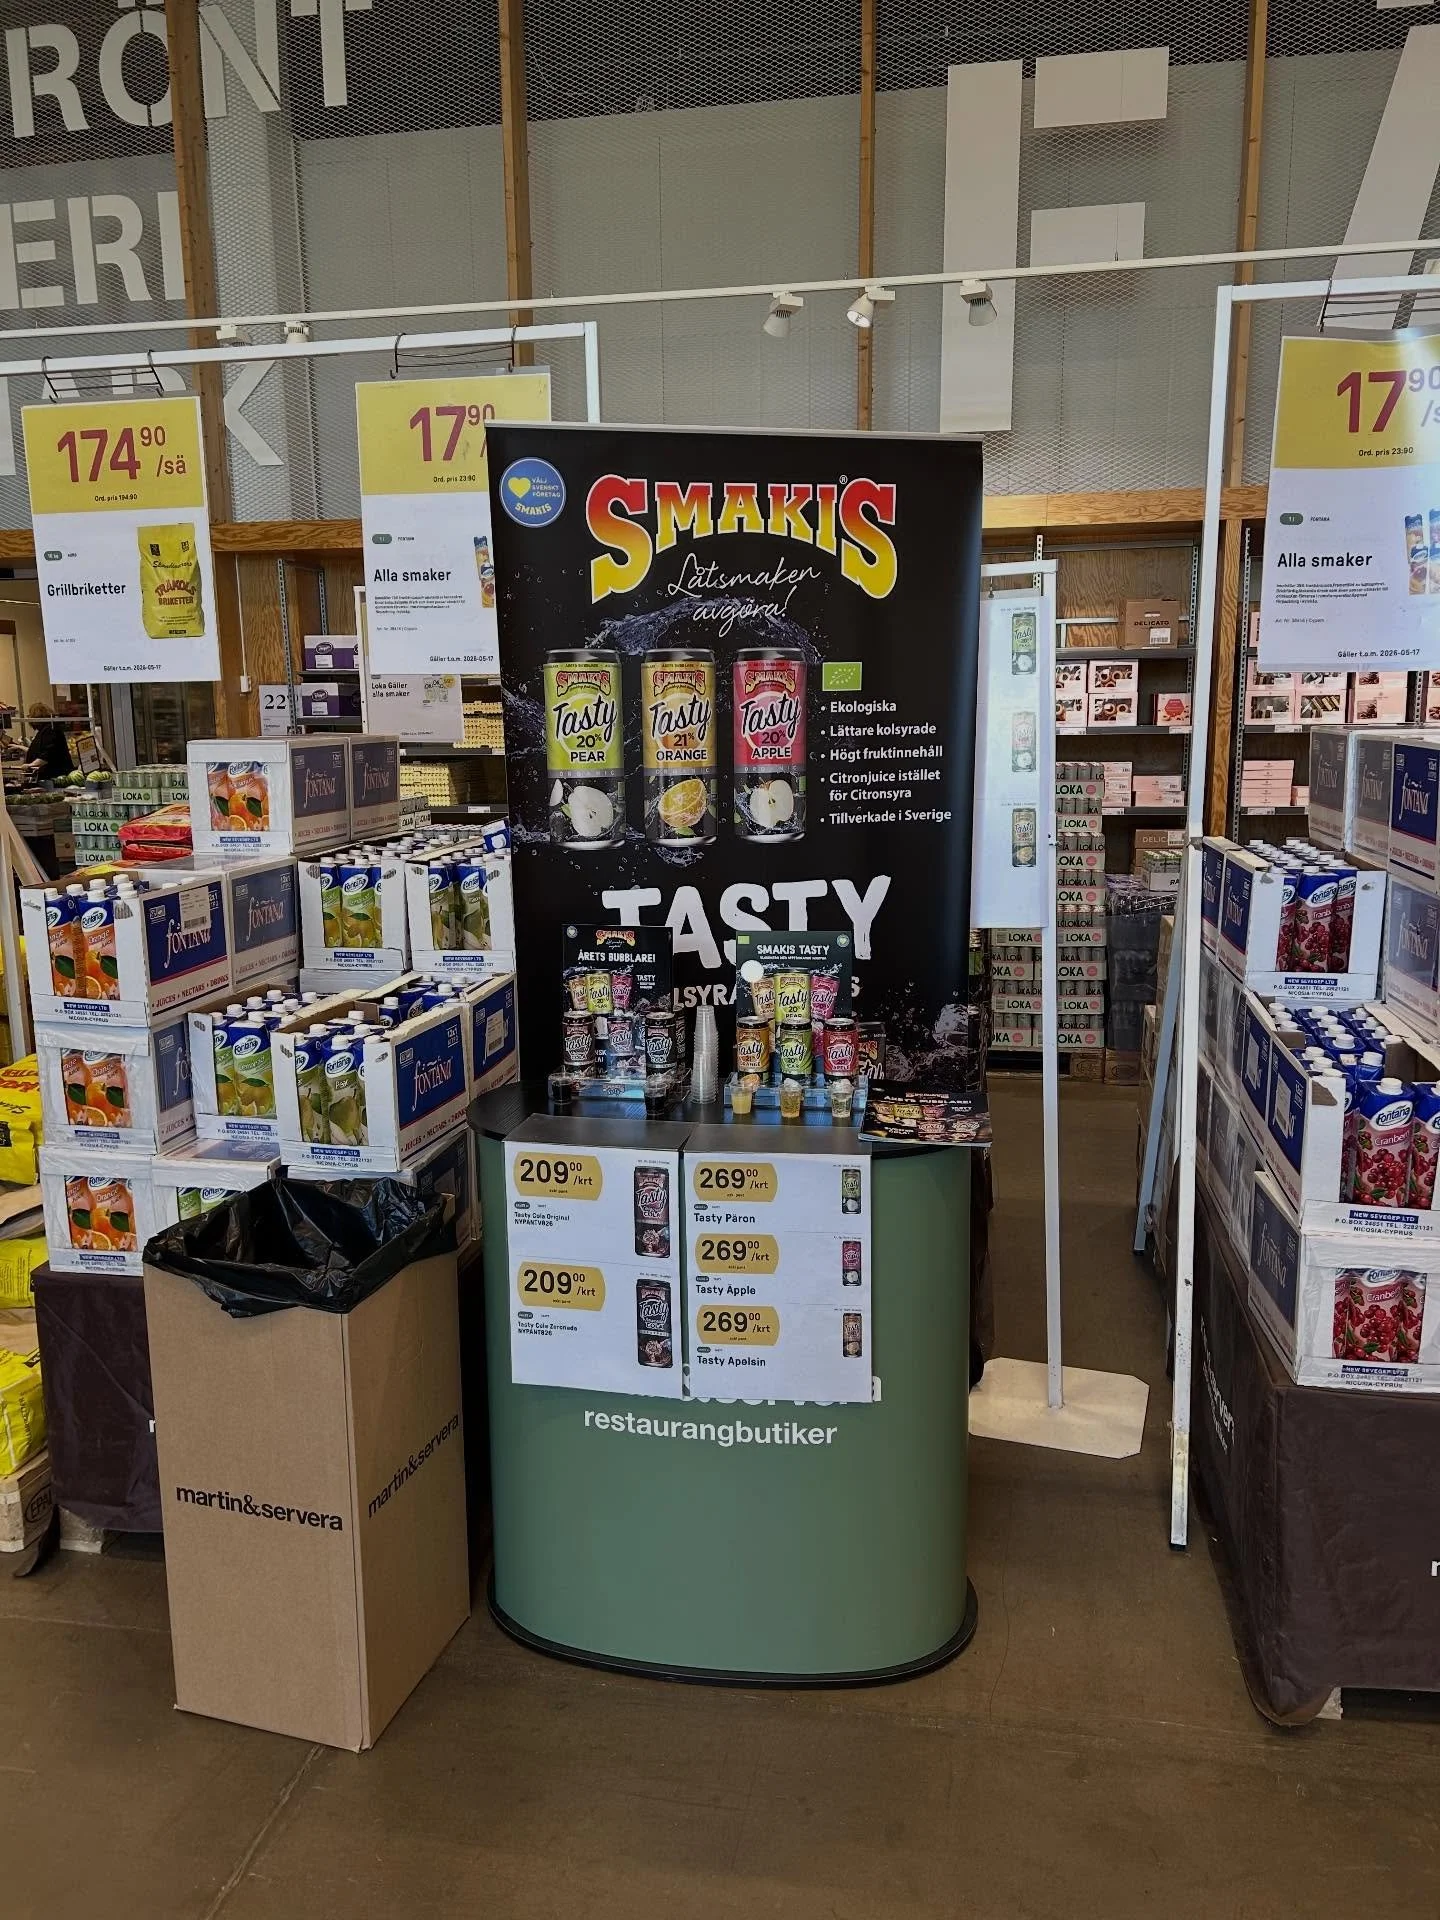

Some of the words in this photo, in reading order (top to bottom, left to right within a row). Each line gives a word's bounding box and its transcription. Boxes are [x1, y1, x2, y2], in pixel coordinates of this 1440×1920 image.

[1337, 370, 1407, 433] 17
[410, 405, 466, 462] 17
[57, 427, 141, 482] 174
[156, 454, 187, 477] /sä
[1375, 449, 1390, 457] pris
[515, 502, 552, 516] SMAKIS
[586, 473, 898, 604] SMAKIS
[1277, 552, 1306, 568] Alla
[1311, 552, 1373, 567] smaker
[373, 568, 398, 582] Alla
[402, 568, 452, 581] smaker
[47, 582, 126, 597] Grillbriketter
[693, 585, 797, 638] avgöra!
[556, 670, 612, 698] SMAKIS
[653, 670, 706, 697] SMAKIS
[744, 669, 797, 696] SMAKIS
[830, 700, 897, 715] Ekologiska
[553, 694, 618, 743] Tasty
[649, 693, 712, 742] Tasty
[740, 692, 802, 738] Tasty
[830, 724, 875, 737] Lättare
[876, 722, 937, 737] kolsyrade
[576, 733, 602, 749] 20%
[673, 732, 695, 747] 21%
[570, 751, 606, 763] PEAR
[656, 749, 708, 761] ORANGE
[752, 746, 791, 759] APPLE
[830, 748, 861, 763] Högt
[863, 745, 943, 760] fruktinnehåll
[829, 770, 896, 785] Citronjuice
[898, 768, 941, 781] istället
[123, 792, 142, 801] LOKA
[829, 789, 848, 801] för
[850, 788, 912, 801] Citronsyra
[1056, 784, 1083, 795] LOKA
[829, 810, 896, 825] Tillverkade
[898, 810, 902, 821] i
[904, 808, 952, 823] Sverige
[1064, 819, 1088, 828] LOKA
[84, 822, 109, 832] LOKA
[85, 854, 105, 862] LOKA
[1057, 855, 1084, 866] OKA
[1057, 891, 1083, 901] OKA
[600, 874, 892, 969] TASTY
[1008, 933, 1032, 942] LOKA
[1066, 933, 1091, 942] LOKA
[578, 949, 606, 962] ÅRETS
[756, 944, 796, 955] SMAKIS
[799, 944, 830, 955] TASTY
[637, 974, 656, 982] TASTY
[1057, 966, 1085, 977] OKA
[778, 989, 809, 1010] Tasty
[1007, 1000, 1031, 1009] LOKA
[1064, 1001, 1089, 1010] LOKA
[827, 1043, 855, 1060] Tasty
[326, 1056, 351, 1071] Fontana
[1376, 1106, 1410, 1127] Fontana
[520, 1158, 569, 1184] 209
[569, 1161, 582, 1172] 00
[746, 1168, 758, 1178] 00
[573, 1175, 593, 1186] /krt
[700, 1167, 745, 1190] 269
[749, 1179, 769, 1190] /krt
[693, 1212, 723, 1225] Tasty
[725, 1212, 756, 1224] Päron
[1353, 1211, 1369, 1219] NEW
[1353, 1226, 1413, 1237] NICOSIA-CYPRUS
[701, 1239, 747, 1262] 269
[747, 1240, 760, 1250] 00
[751, 1252, 770, 1262] /krt
[523, 1269, 572, 1295] 209
[572, 1272, 585, 1283] 00
[576, 1286, 596, 1297] /krt
[695, 1284, 724, 1297] Tasty
[726, 1283, 756, 1297] Äpple
[703, 1311, 748, 1333] 269
[748, 1312, 761, 1321] 00
[752, 1324, 771, 1333] /krt
[697, 1355, 725, 1367] Tasty
[727, 1356, 767, 1368] Apelsin
[584, 1410, 838, 1448] restaurangbutiker
[368, 1414, 459, 1518] martin&servera
[176, 1486, 343, 1531] martin&servera
